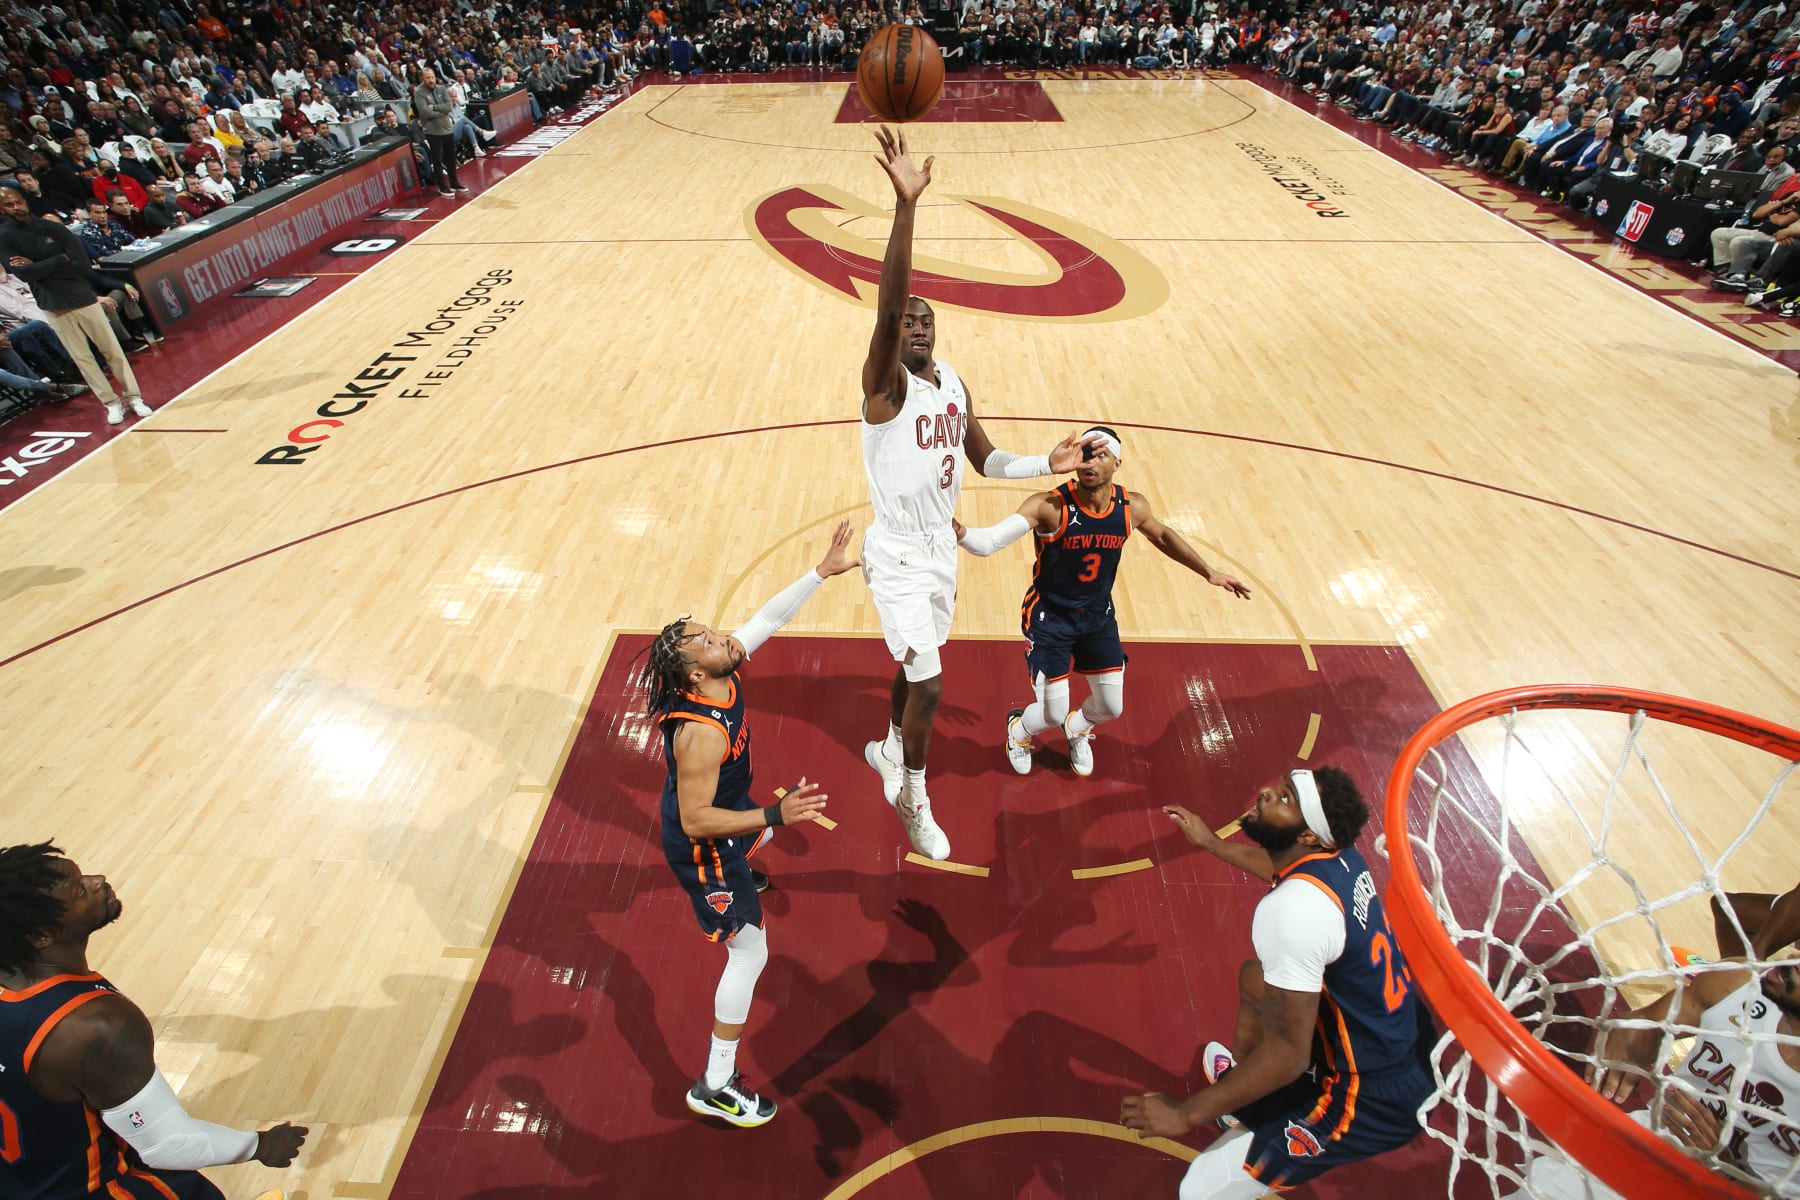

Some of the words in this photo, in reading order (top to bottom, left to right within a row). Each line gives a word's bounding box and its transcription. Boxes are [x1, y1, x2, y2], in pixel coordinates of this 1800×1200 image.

[1003, 70, 1239, 80] CAVALIERS
[1272, 177, 1350, 217] ROCKET
[184, 260, 217, 304] GET
[212, 244, 250, 290] INTO
[243, 219, 297, 273] PLAYOFF
[292, 203, 328, 246] MODE
[321, 192, 352, 230] WITH
[346, 182, 369, 216] THE
[364, 174, 387, 206] NBA
[381, 166, 399, 198] APP
[1631, 211, 1648, 235] TV
[331, 238, 398, 253] 6
[398, 299, 524, 398] FIELDHOUSE
[254, 352, 418, 464] ROCKET
[393, 269, 513, 347] Mortgage
[940, 454, 955, 490] 3
[1062, 535, 1094, 549] NEW
[1095, 534, 1126, 549] YORK
[1078, 553, 1101, 582] 3
